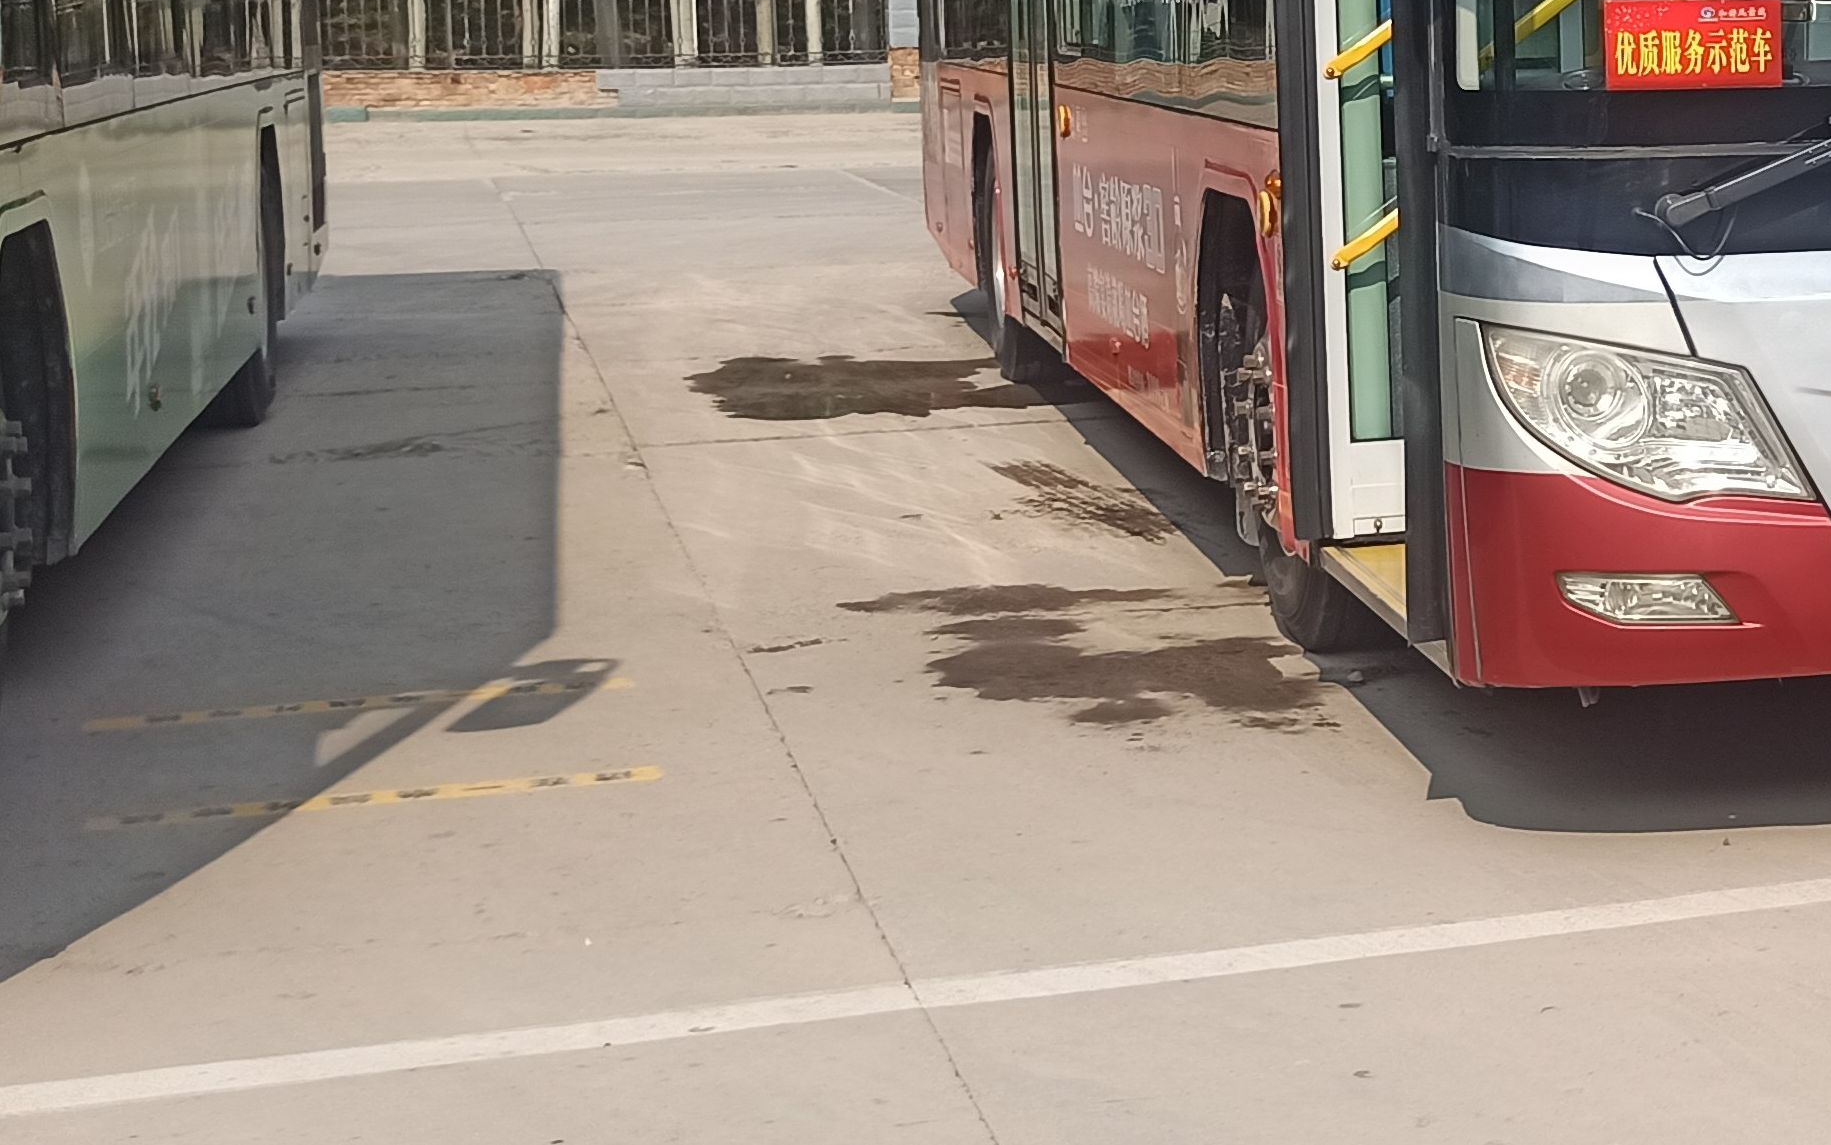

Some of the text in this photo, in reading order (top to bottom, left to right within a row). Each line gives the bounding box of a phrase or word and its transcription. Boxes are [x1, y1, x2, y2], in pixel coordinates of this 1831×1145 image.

[1614, 27, 1773, 77] 优质服务示范车
